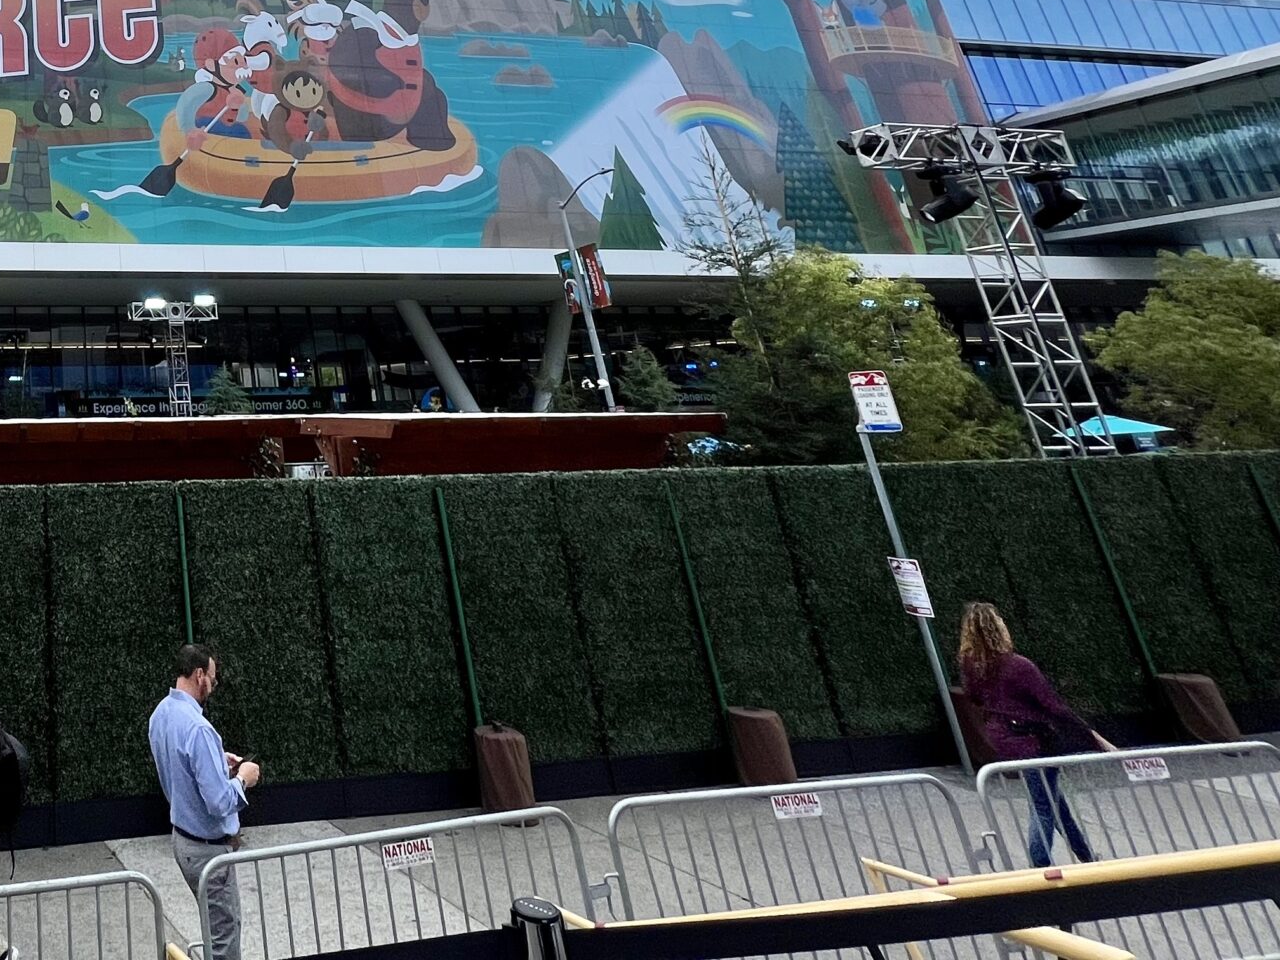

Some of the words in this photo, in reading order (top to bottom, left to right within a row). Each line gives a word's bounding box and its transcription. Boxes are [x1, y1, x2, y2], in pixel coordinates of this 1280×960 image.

[93, 402, 156, 416] Experince
[1124, 758, 1166, 770] NATIONAL
[773, 794, 819, 808] NATIONAL
[383, 838, 433, 858] NATIONAL
